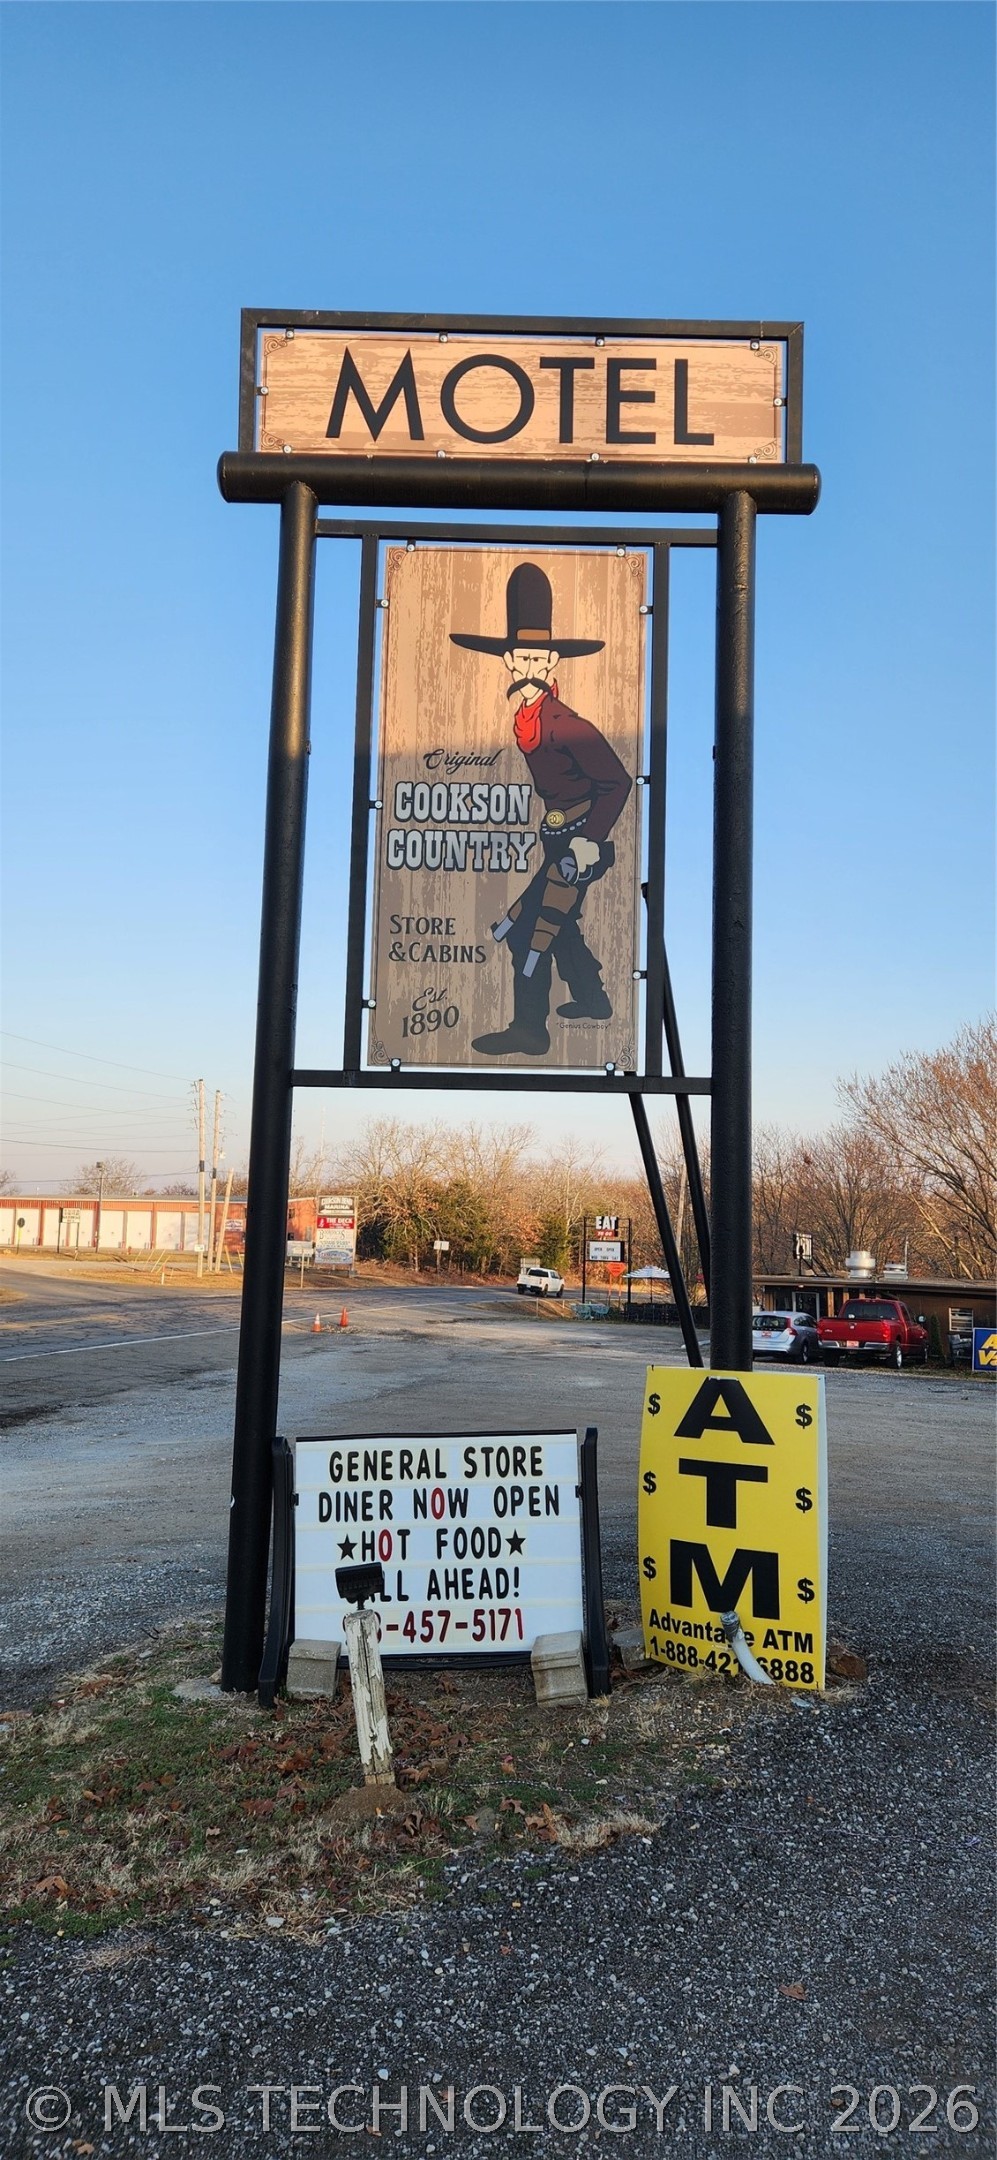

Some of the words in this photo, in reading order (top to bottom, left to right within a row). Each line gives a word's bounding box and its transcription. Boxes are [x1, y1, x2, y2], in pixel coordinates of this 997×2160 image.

[325, 346, 715, 446] MOTEL
[423, 748, 504, 775] Original
[394, 780, 532, 825] COOKSON
[386, 828, 537, 872] COUNTRY
[389, 914, 456, 936] STORE
[411, 986, 448, 1012] Est.
[401, 1005, 460, 1038] 1890
[596, 1215, 617, 1230] EAT
[329, 1447, 447, 1483] GENERAL
[463, 1445, 544, 1479] STORE
[318, 1489, 393, 1523] DINER
[413, 1487, 468, 1520] NOW
[493, 1484, 560, 1518] OPEN
[361, 1528, 411, 1562] HOT
[436, 1526, 502, 1560] FOOD
[427, 1566, 520, 1601] AHEAD!
[342, 1608, 525, 1645] -457-5171
[649, 1608, 755, 1649] Advantae
[762, 1628, 814, 1654] ATM
